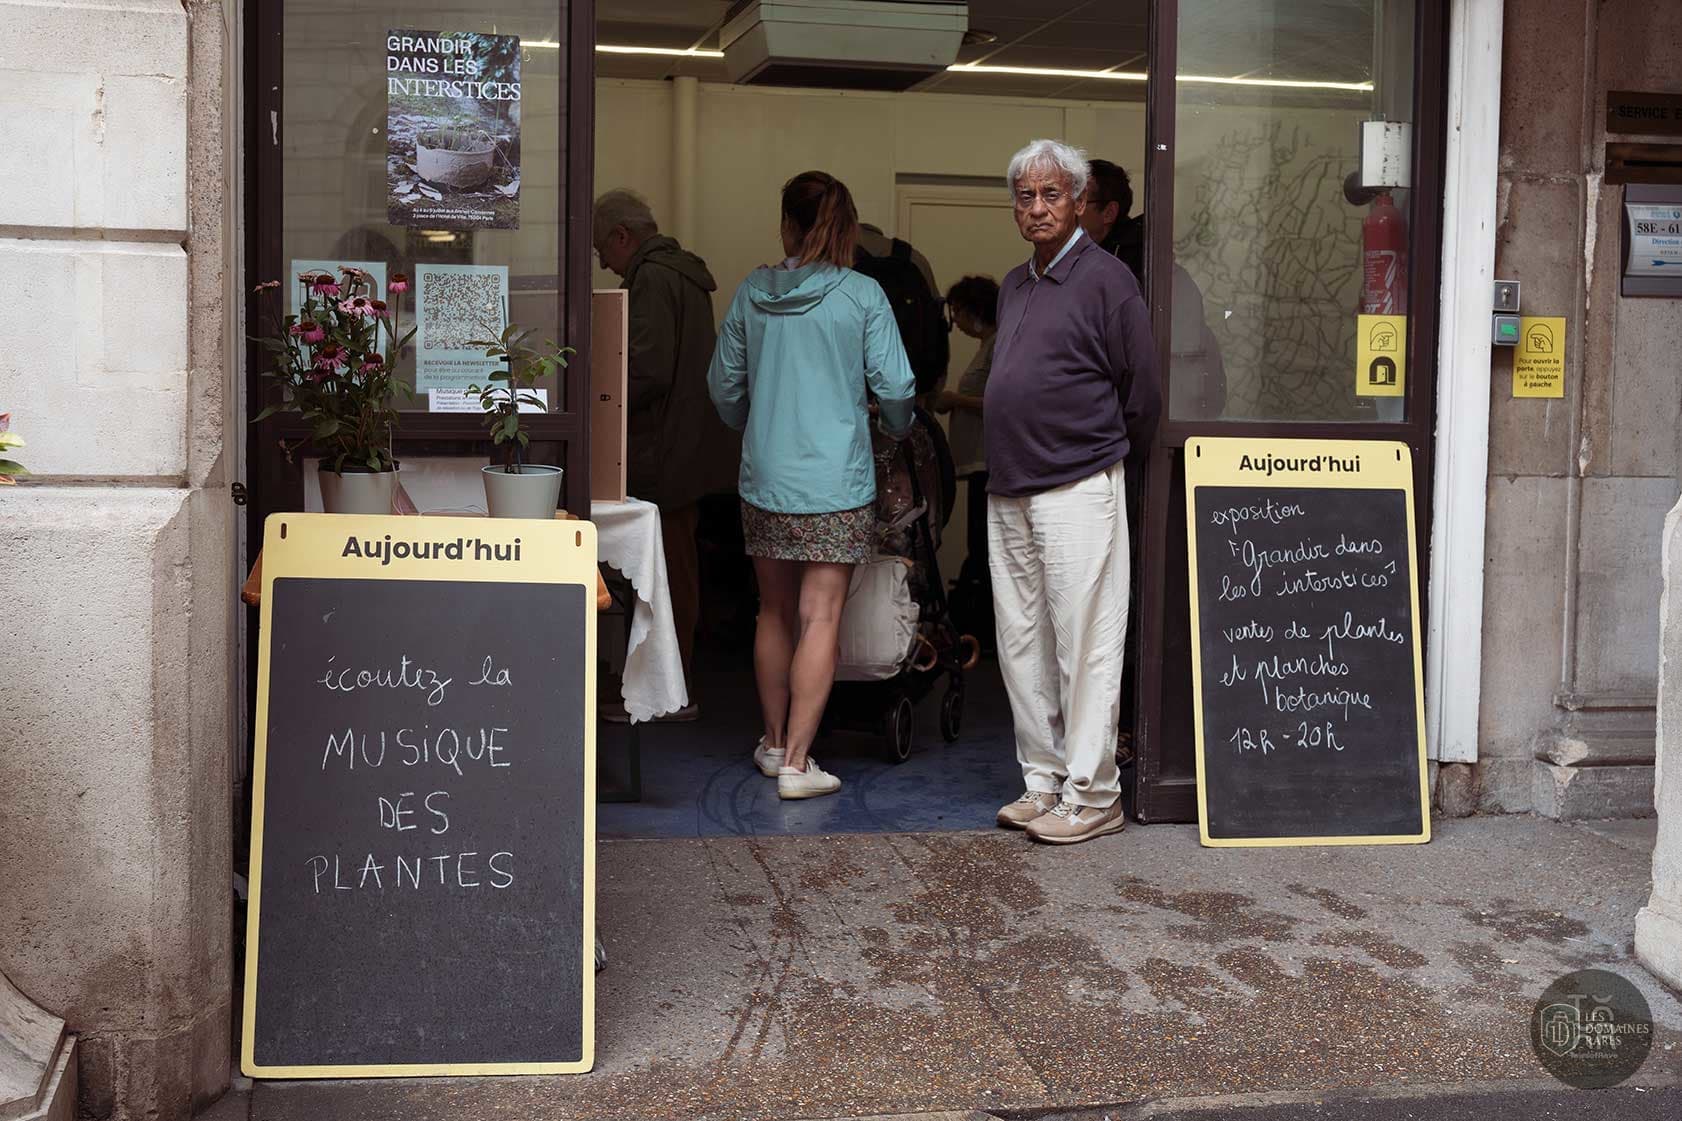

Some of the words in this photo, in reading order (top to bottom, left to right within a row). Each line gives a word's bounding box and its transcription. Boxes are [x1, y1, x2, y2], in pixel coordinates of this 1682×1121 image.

[387, 36, 472, 54] GRANDIR
[387, 56, 439, 73] DANS
[444, 59, 477, 75] LES
[387, 77, 520, 100] INTERSTICES
[1617, 105, 1668, 119] SERVICE
[1637, 222, 1658, 234] 58E
[1529, 381, 1552, 389] gauche
[1239, 454, 1360, 476] Aujourd'hui
[1210, 498, 1305, 535] exposition
[341, 534, 521, 566] Aujourd'hui
[1335, 533, 1383, 556] dans
[1218, 575, 1247, 601] les
[1223, 619, 1274, 643] ventes
[1284, 620, 1311, 640] de
[1319, 611, 1405, 660] plantes
[317, 654, 453, 706] écoutez
[468, 655, 513, 687] la
[1219, 653, 1247, 687] et
[1254, 653, 1349, 705] planches
[1275, 685, 1373, 722] botanique
[1230, 727, 1276, 755] 12h
[1296, 720, 1345, 751] 20h
[378, 791, 450, 834] DES
[304, 852, 514, 894] PLANTES
